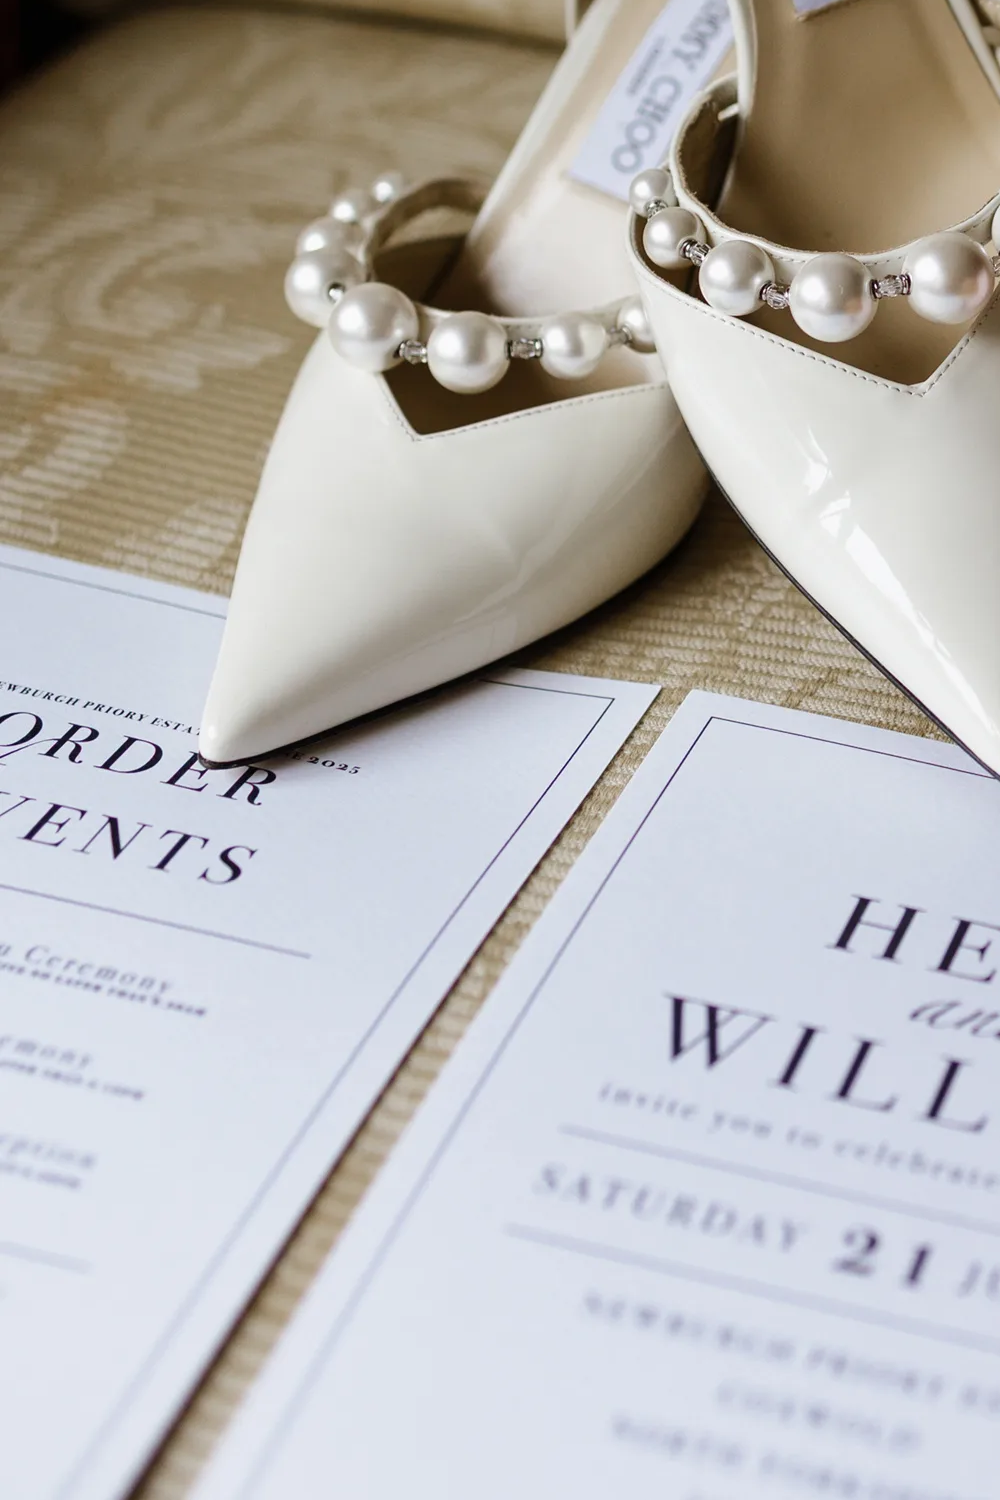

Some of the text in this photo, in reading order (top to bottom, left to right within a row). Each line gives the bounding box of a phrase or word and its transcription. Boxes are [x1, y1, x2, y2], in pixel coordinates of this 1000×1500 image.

[610, 73, 683, 176] CHOO
[0, 711, 277, 806] ORDER
[82, 700, 150, 722] PRIORY
[306, 755, 361, 775] 2025
[598, 1081, 699, 1121] invite
[706, 1109, 773, 1138] you
[784, 1124, 823, 1150] to
[832, 1136, 1000, 1190] celebrate
[532, 1161, 806, 1252] SATURDAY
[829, 1222, 934, 1288] 21
